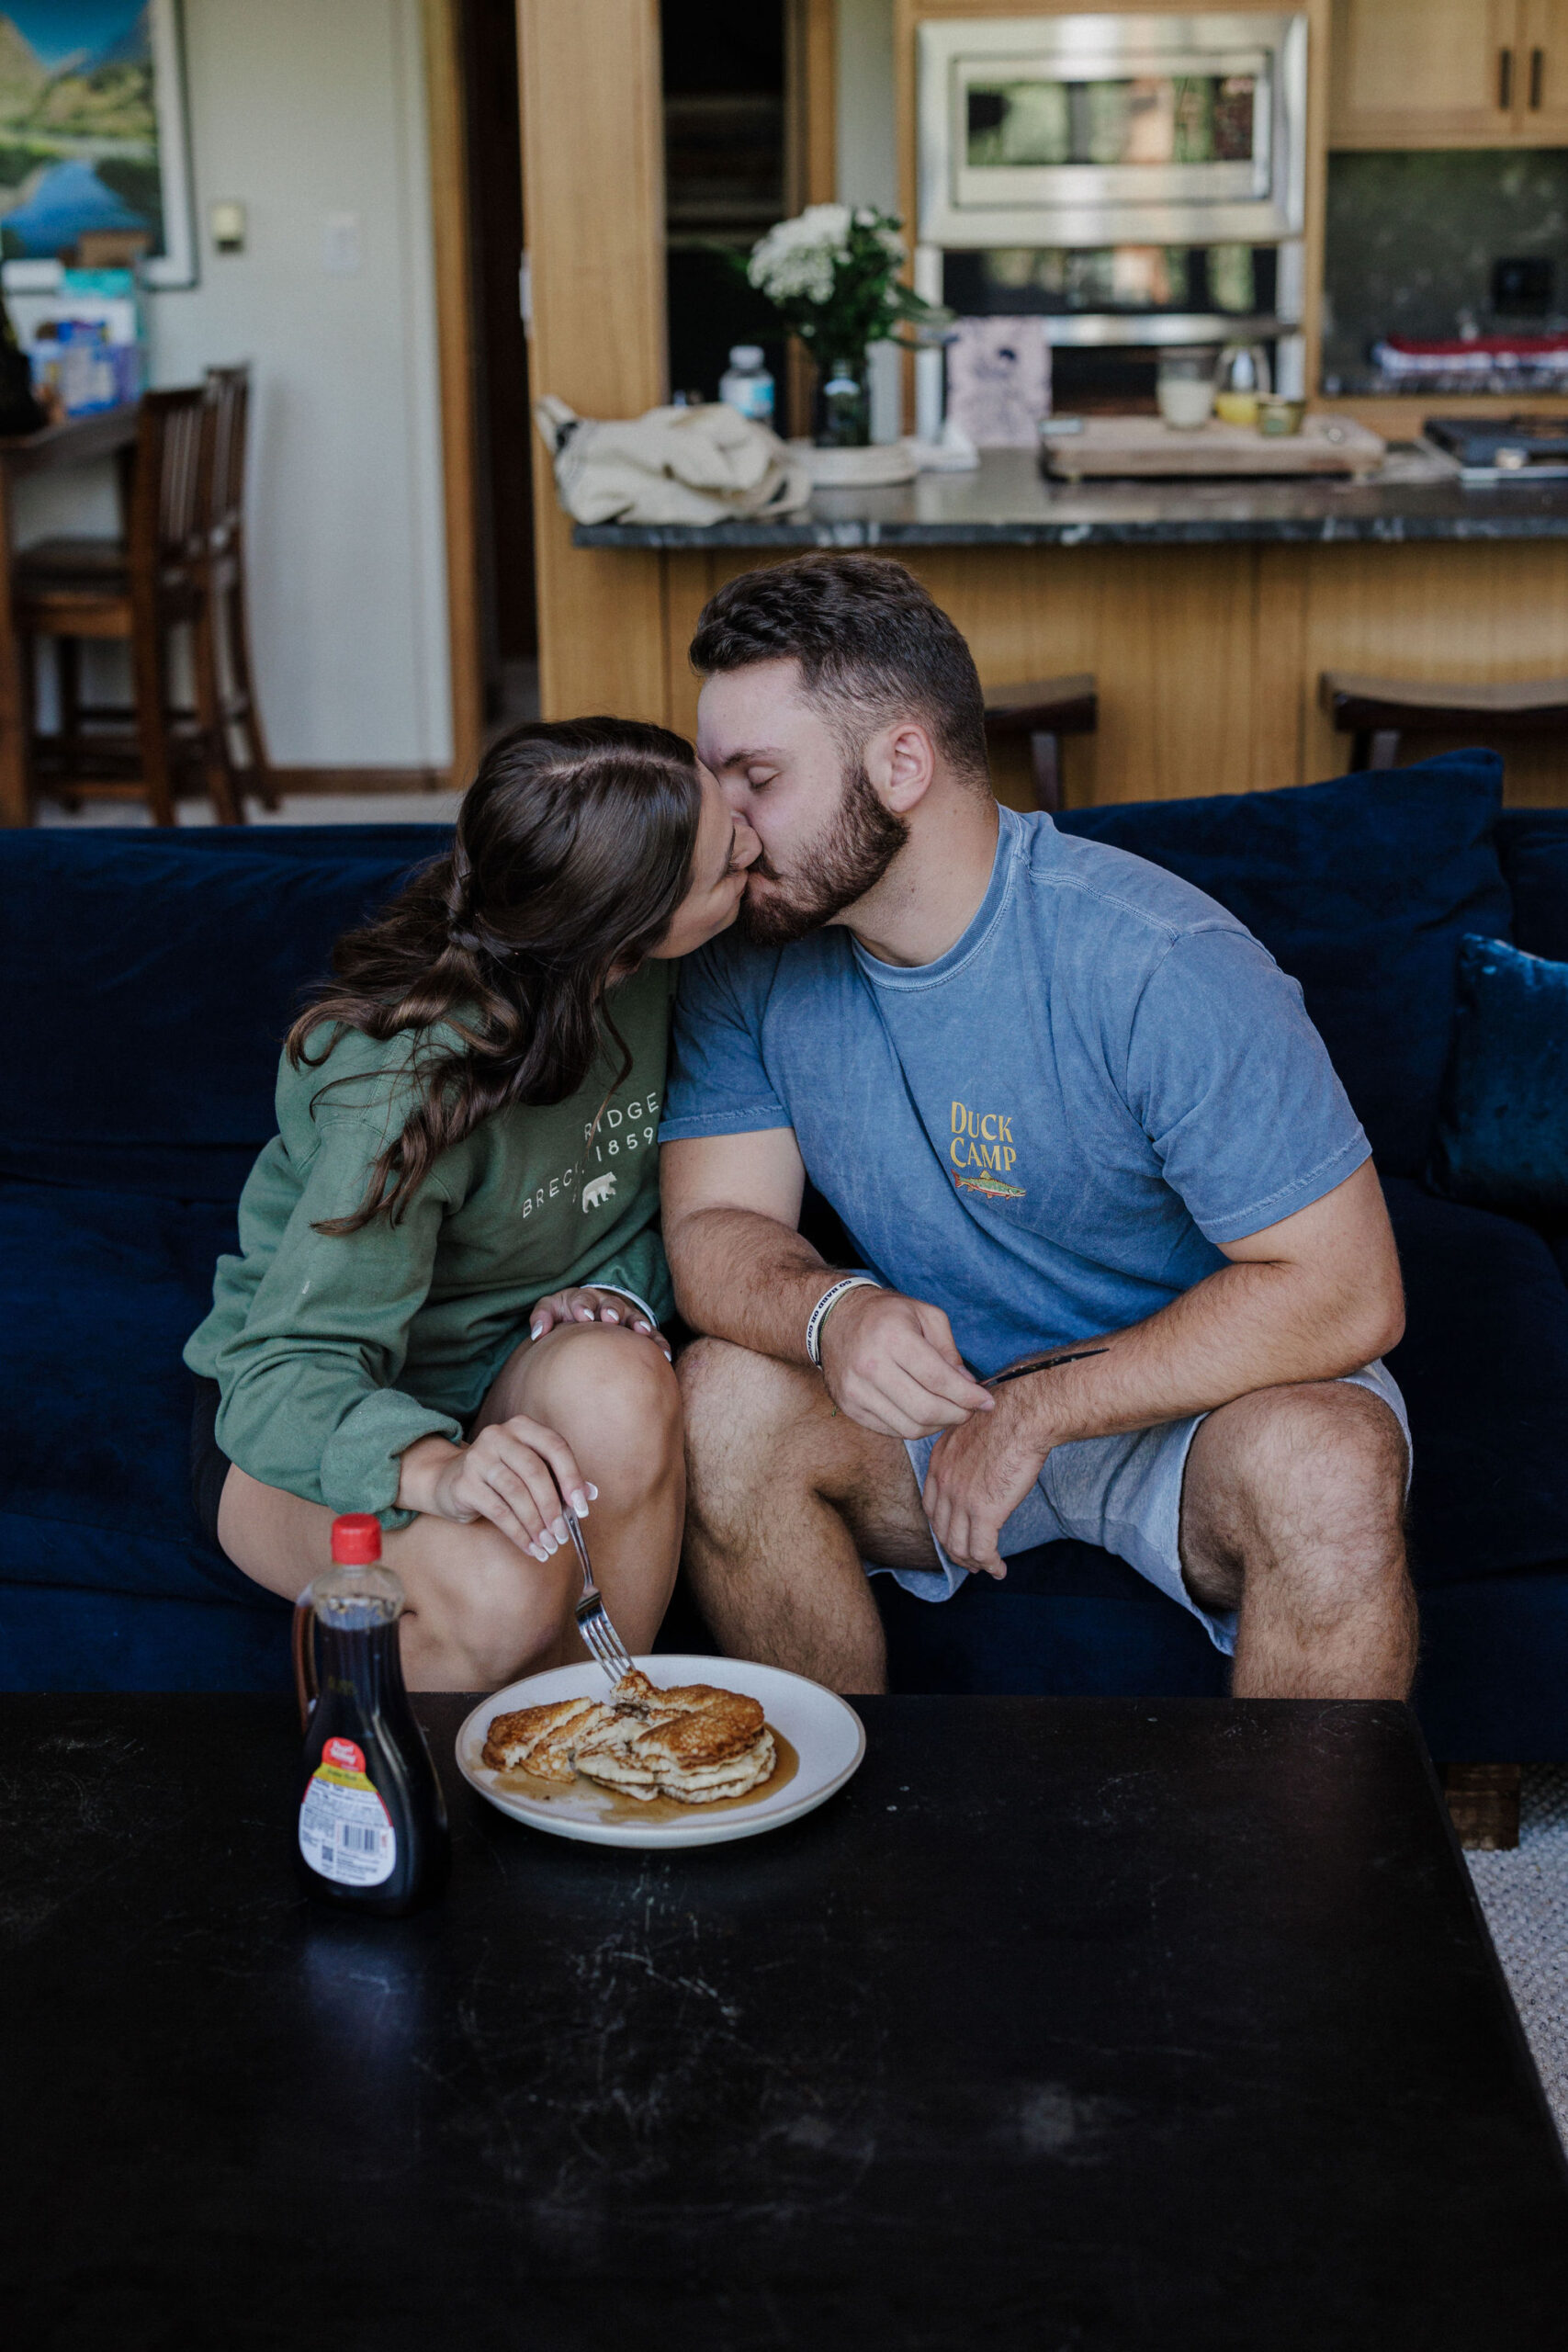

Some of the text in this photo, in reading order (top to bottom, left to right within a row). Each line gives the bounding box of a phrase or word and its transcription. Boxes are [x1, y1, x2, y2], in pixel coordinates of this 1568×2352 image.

[951, 1101, 1014, 1144] DUCK
[595, 1126, 654, 1162] 1859
[950, 1136, 1017, 1171] CAMP
[523, 1167, 576, 1218] BREC
[818, 1286, 839, 1308] HARD
[808, 1325, 814, 1339] GO
[811, 1310, 819, 1323] OR
